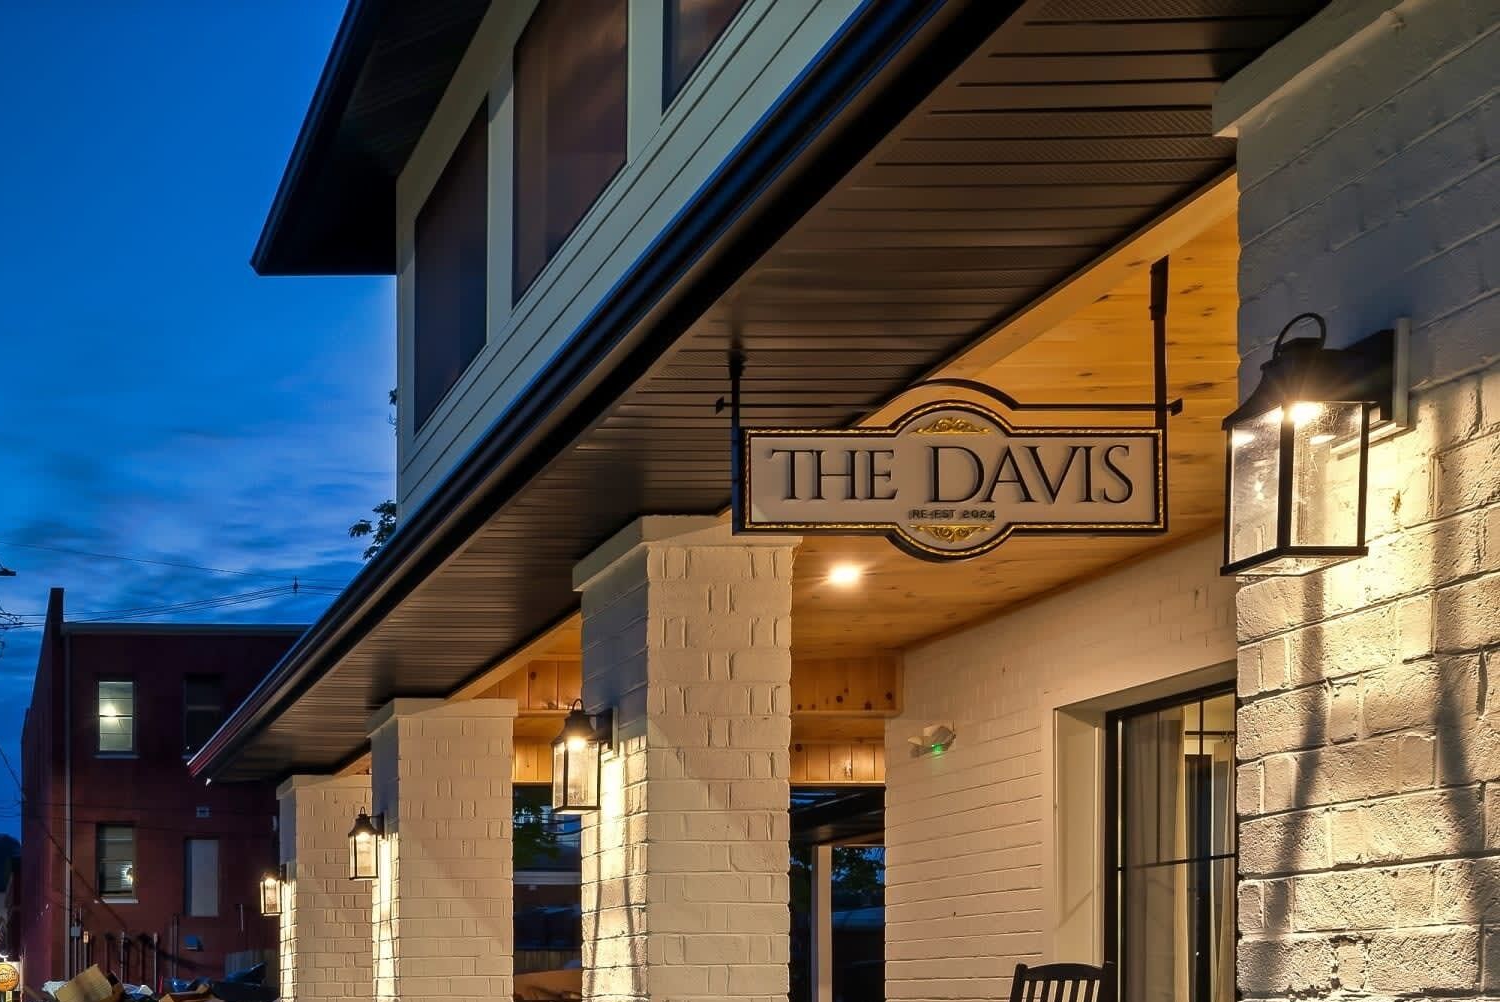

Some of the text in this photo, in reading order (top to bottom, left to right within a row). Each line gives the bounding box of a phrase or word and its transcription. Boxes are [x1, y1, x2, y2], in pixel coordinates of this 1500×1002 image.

[771, 444, 1135, 505] THE DAVIS
[963, 509, 996, 521] 2024
